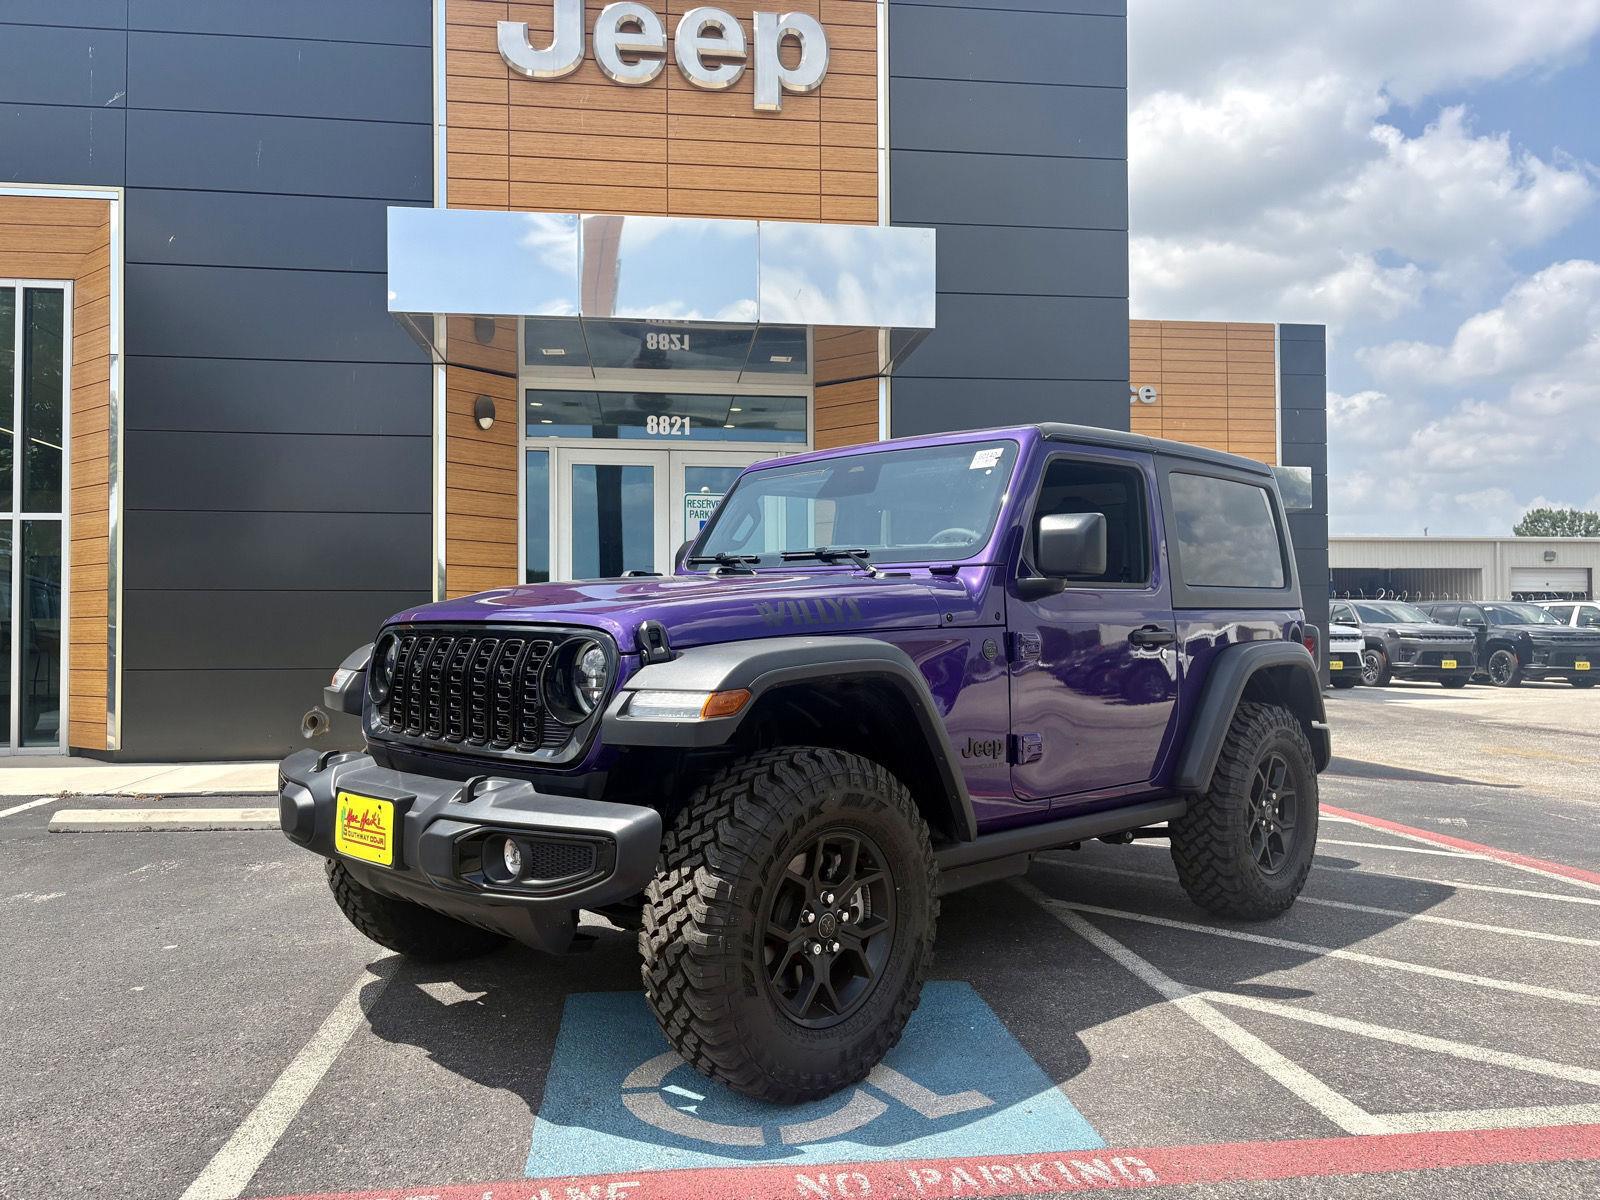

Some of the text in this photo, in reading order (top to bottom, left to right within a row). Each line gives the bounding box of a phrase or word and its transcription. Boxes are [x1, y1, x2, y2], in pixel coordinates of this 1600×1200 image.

[497, 0, 830, 112] Jeep
[646, 415, 691, 436] 8821
[752, 597, 863, 627] WILLYS
[961, 736, 1003, 760] Jeep
[794, 1156, 1160, 1200] NO PARKING
